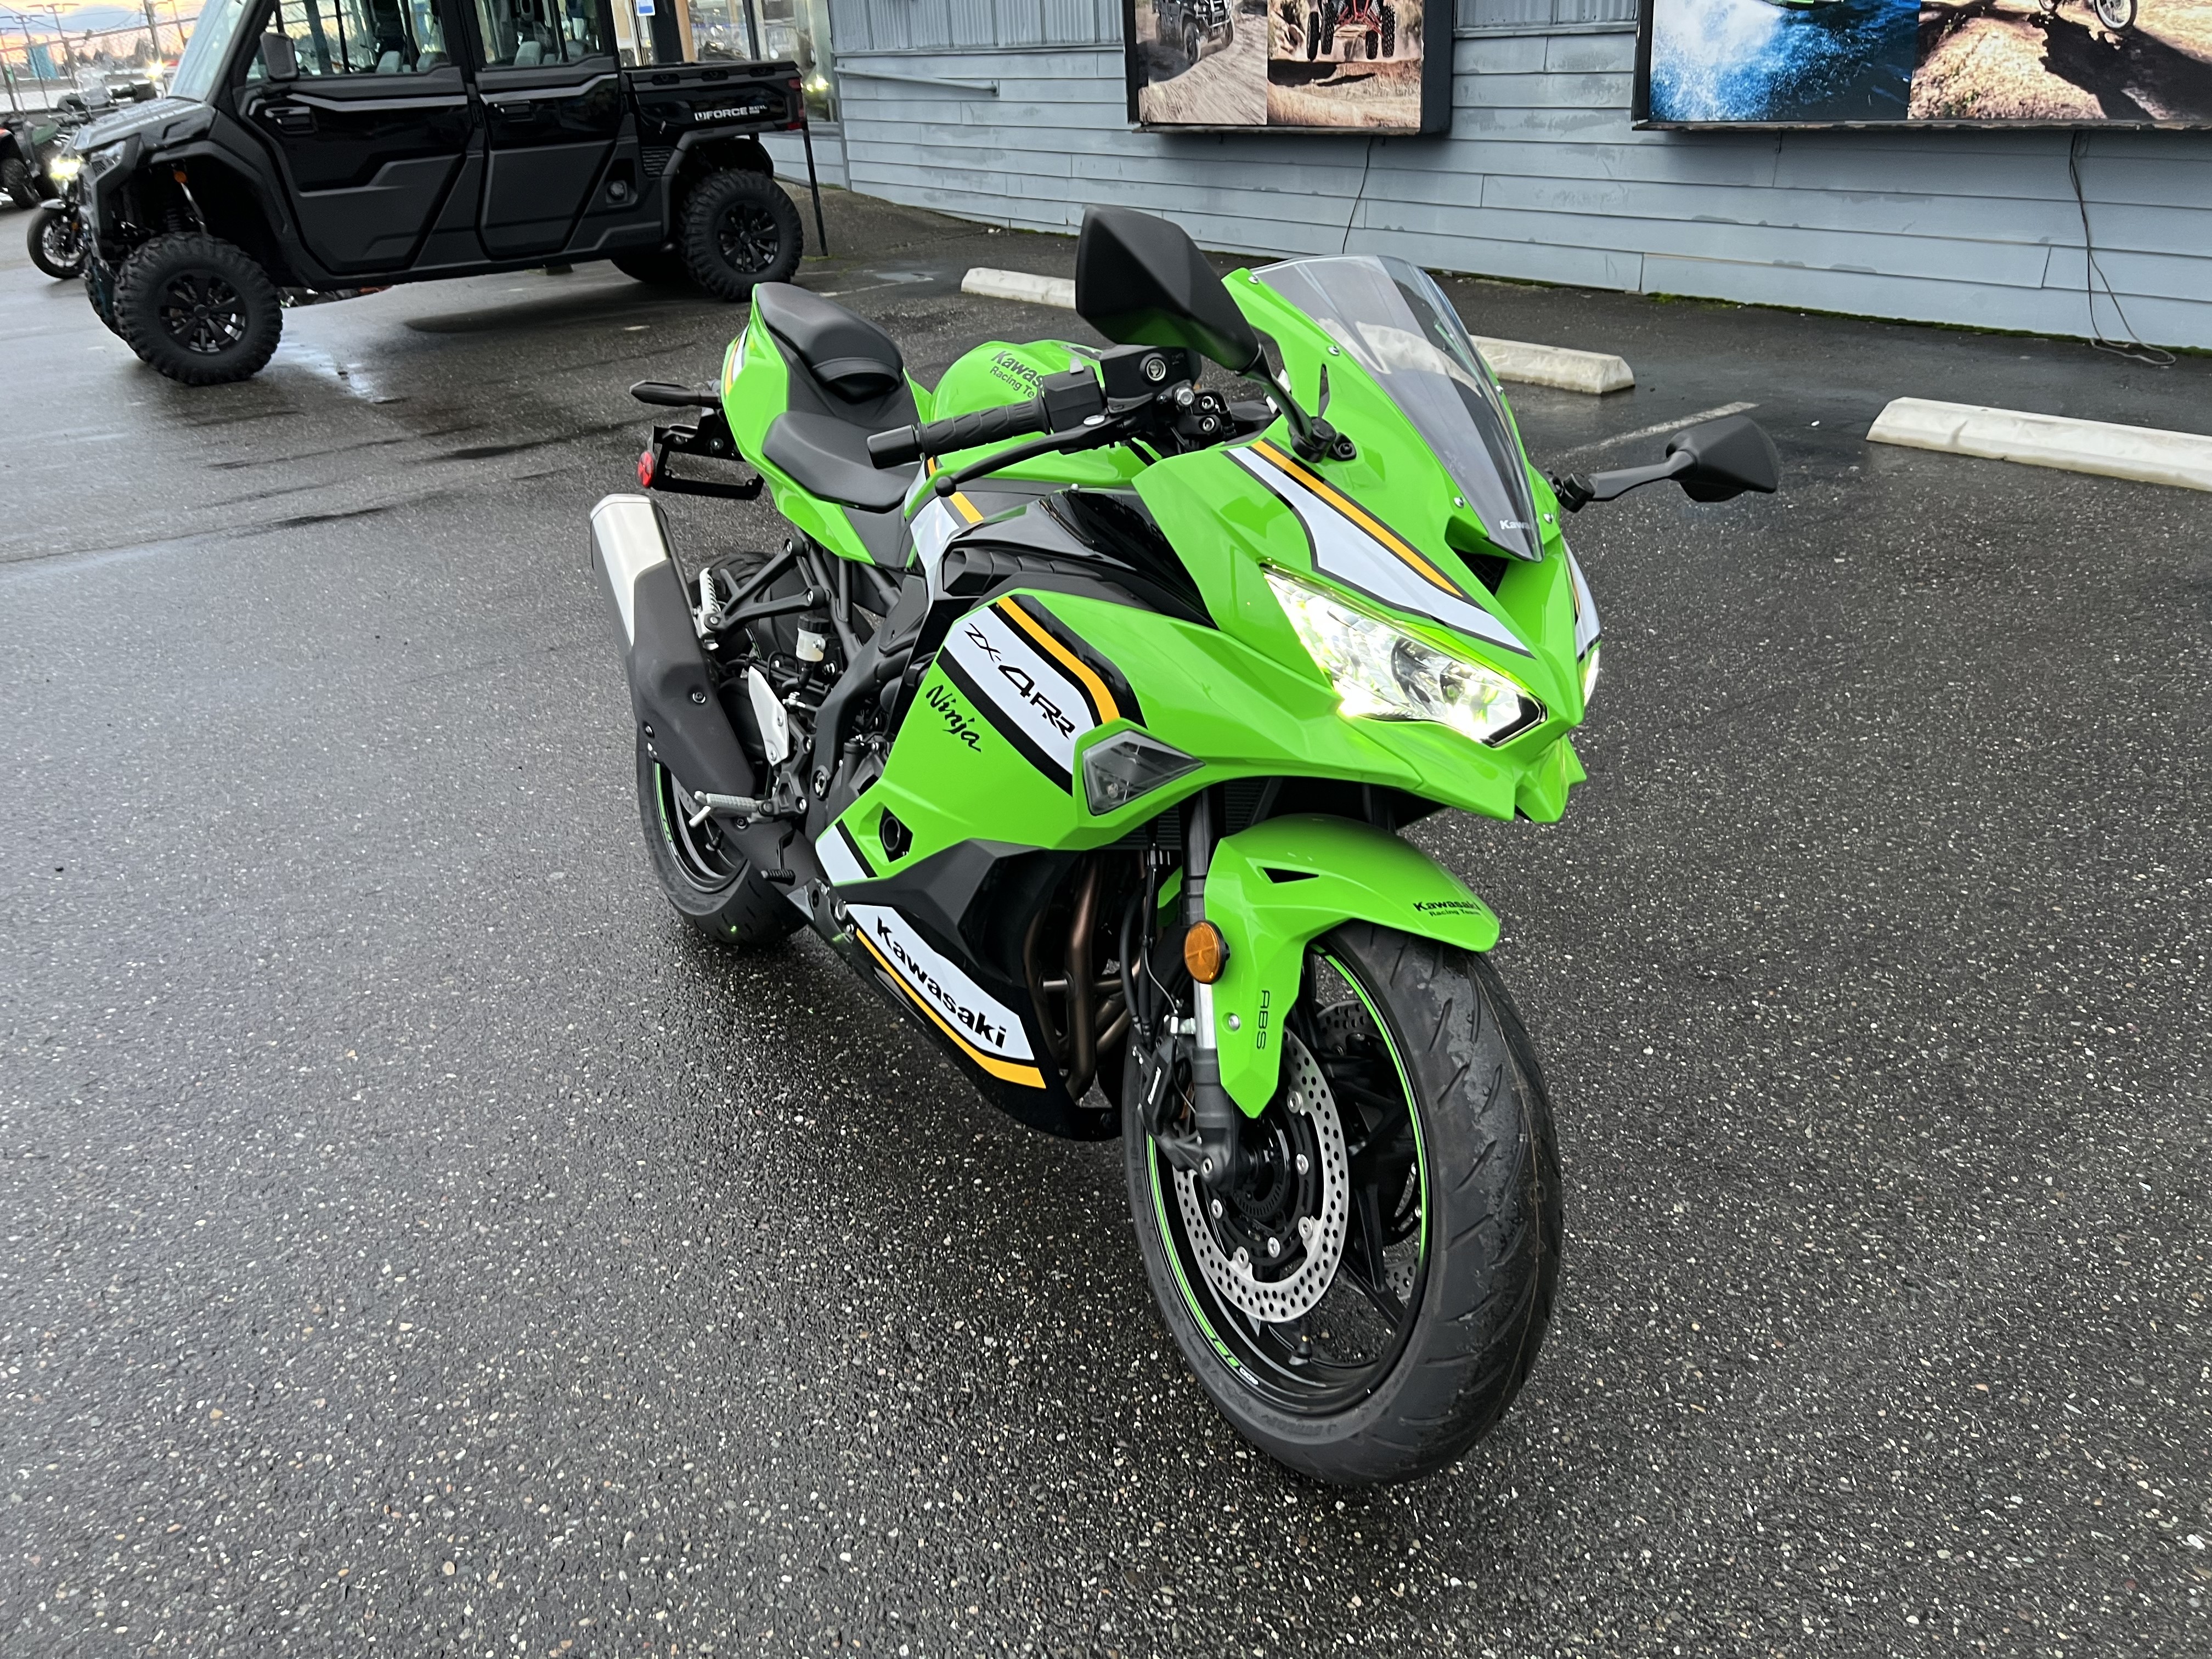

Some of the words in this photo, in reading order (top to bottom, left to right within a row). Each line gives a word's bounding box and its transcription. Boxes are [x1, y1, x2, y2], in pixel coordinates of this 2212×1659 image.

[990, 366, 1023, 391] Racing
[1023, 385, 1035, 398] Te
[991, 351, 1043, 387] Kawas
[926, 684, 981, 753] Ninja
[877, 915, 1007, 1049] Kawasaki
[1256, 990, 1270, 1050] ABS
